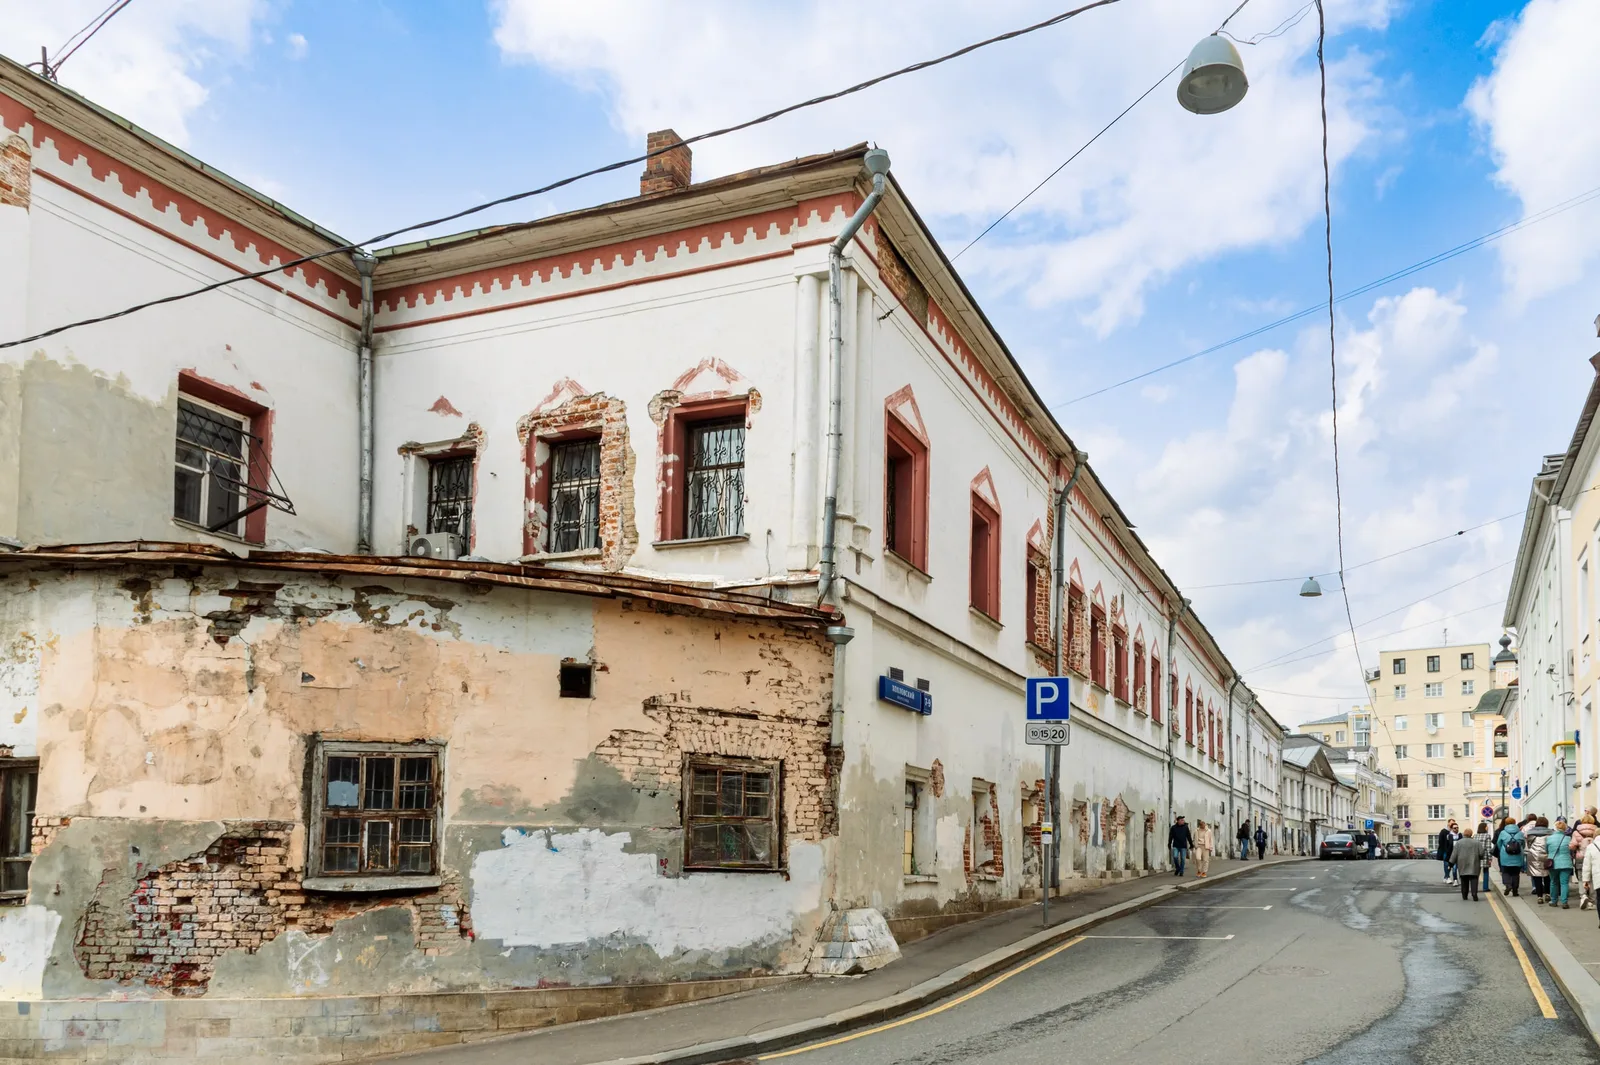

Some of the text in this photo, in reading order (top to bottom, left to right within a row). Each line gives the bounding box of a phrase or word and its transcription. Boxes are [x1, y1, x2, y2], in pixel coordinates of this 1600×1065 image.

[1036, 682, 1059, 714] P
[1040, 729, 1049, 738] 15
[1051, 729, 1065, 739] 20
